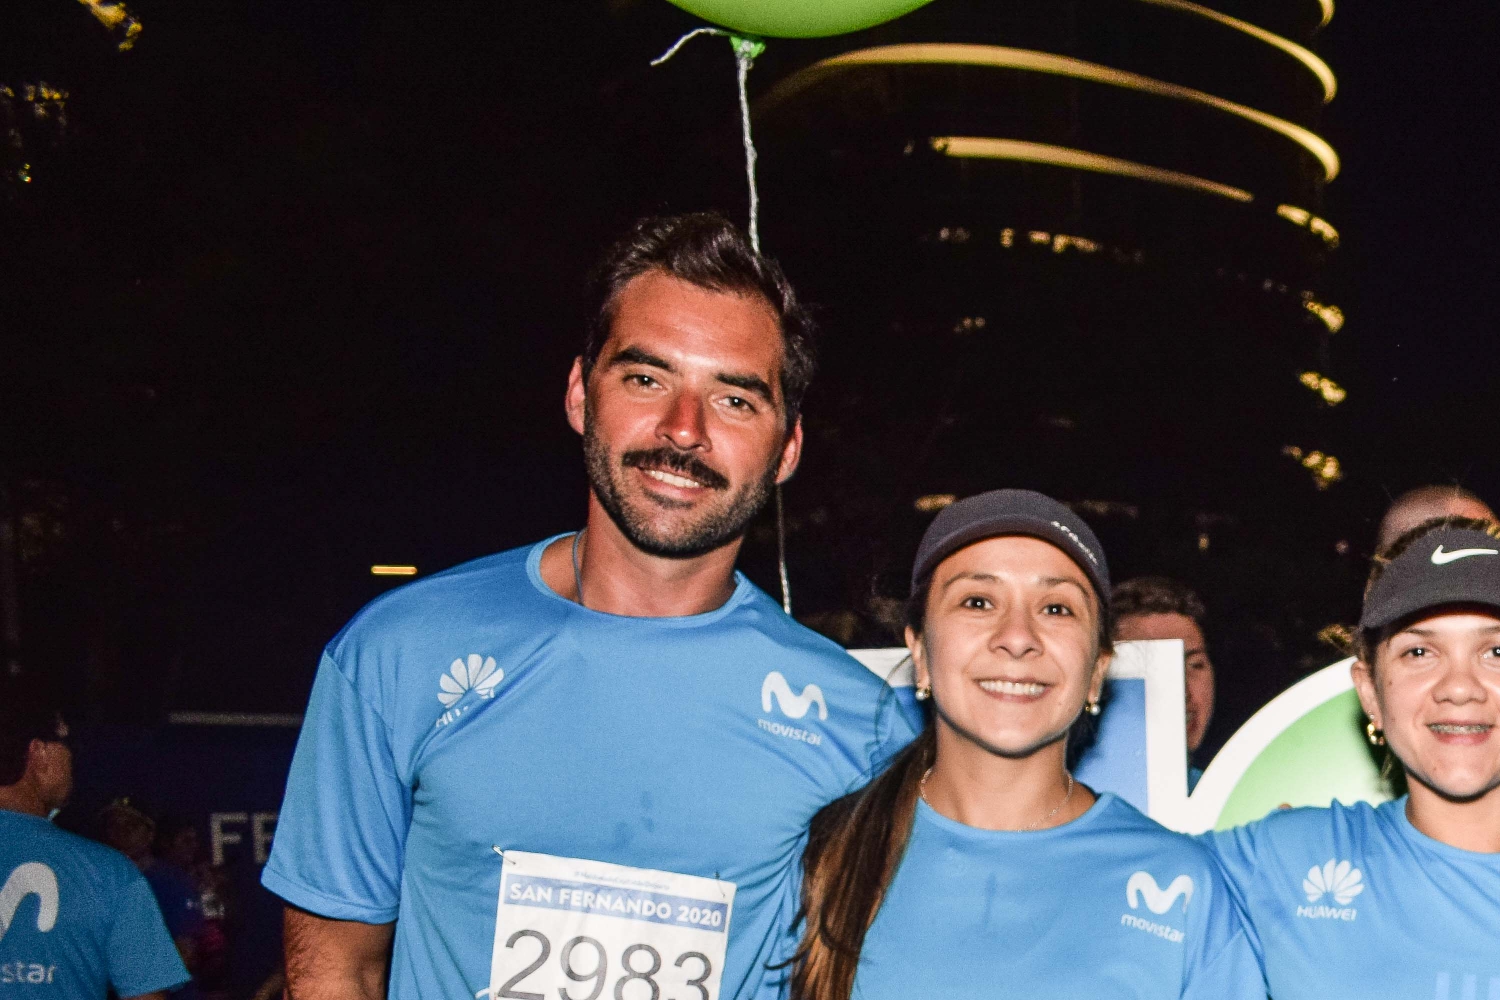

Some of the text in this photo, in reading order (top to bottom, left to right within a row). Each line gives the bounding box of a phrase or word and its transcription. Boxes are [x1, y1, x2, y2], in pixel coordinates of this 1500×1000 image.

[510, 882, 722, 928] SAN FERNANDO 2020
[1296, 905, 1357, 921] HUAWEI
[1121, 913, 1185, 944] movistar
